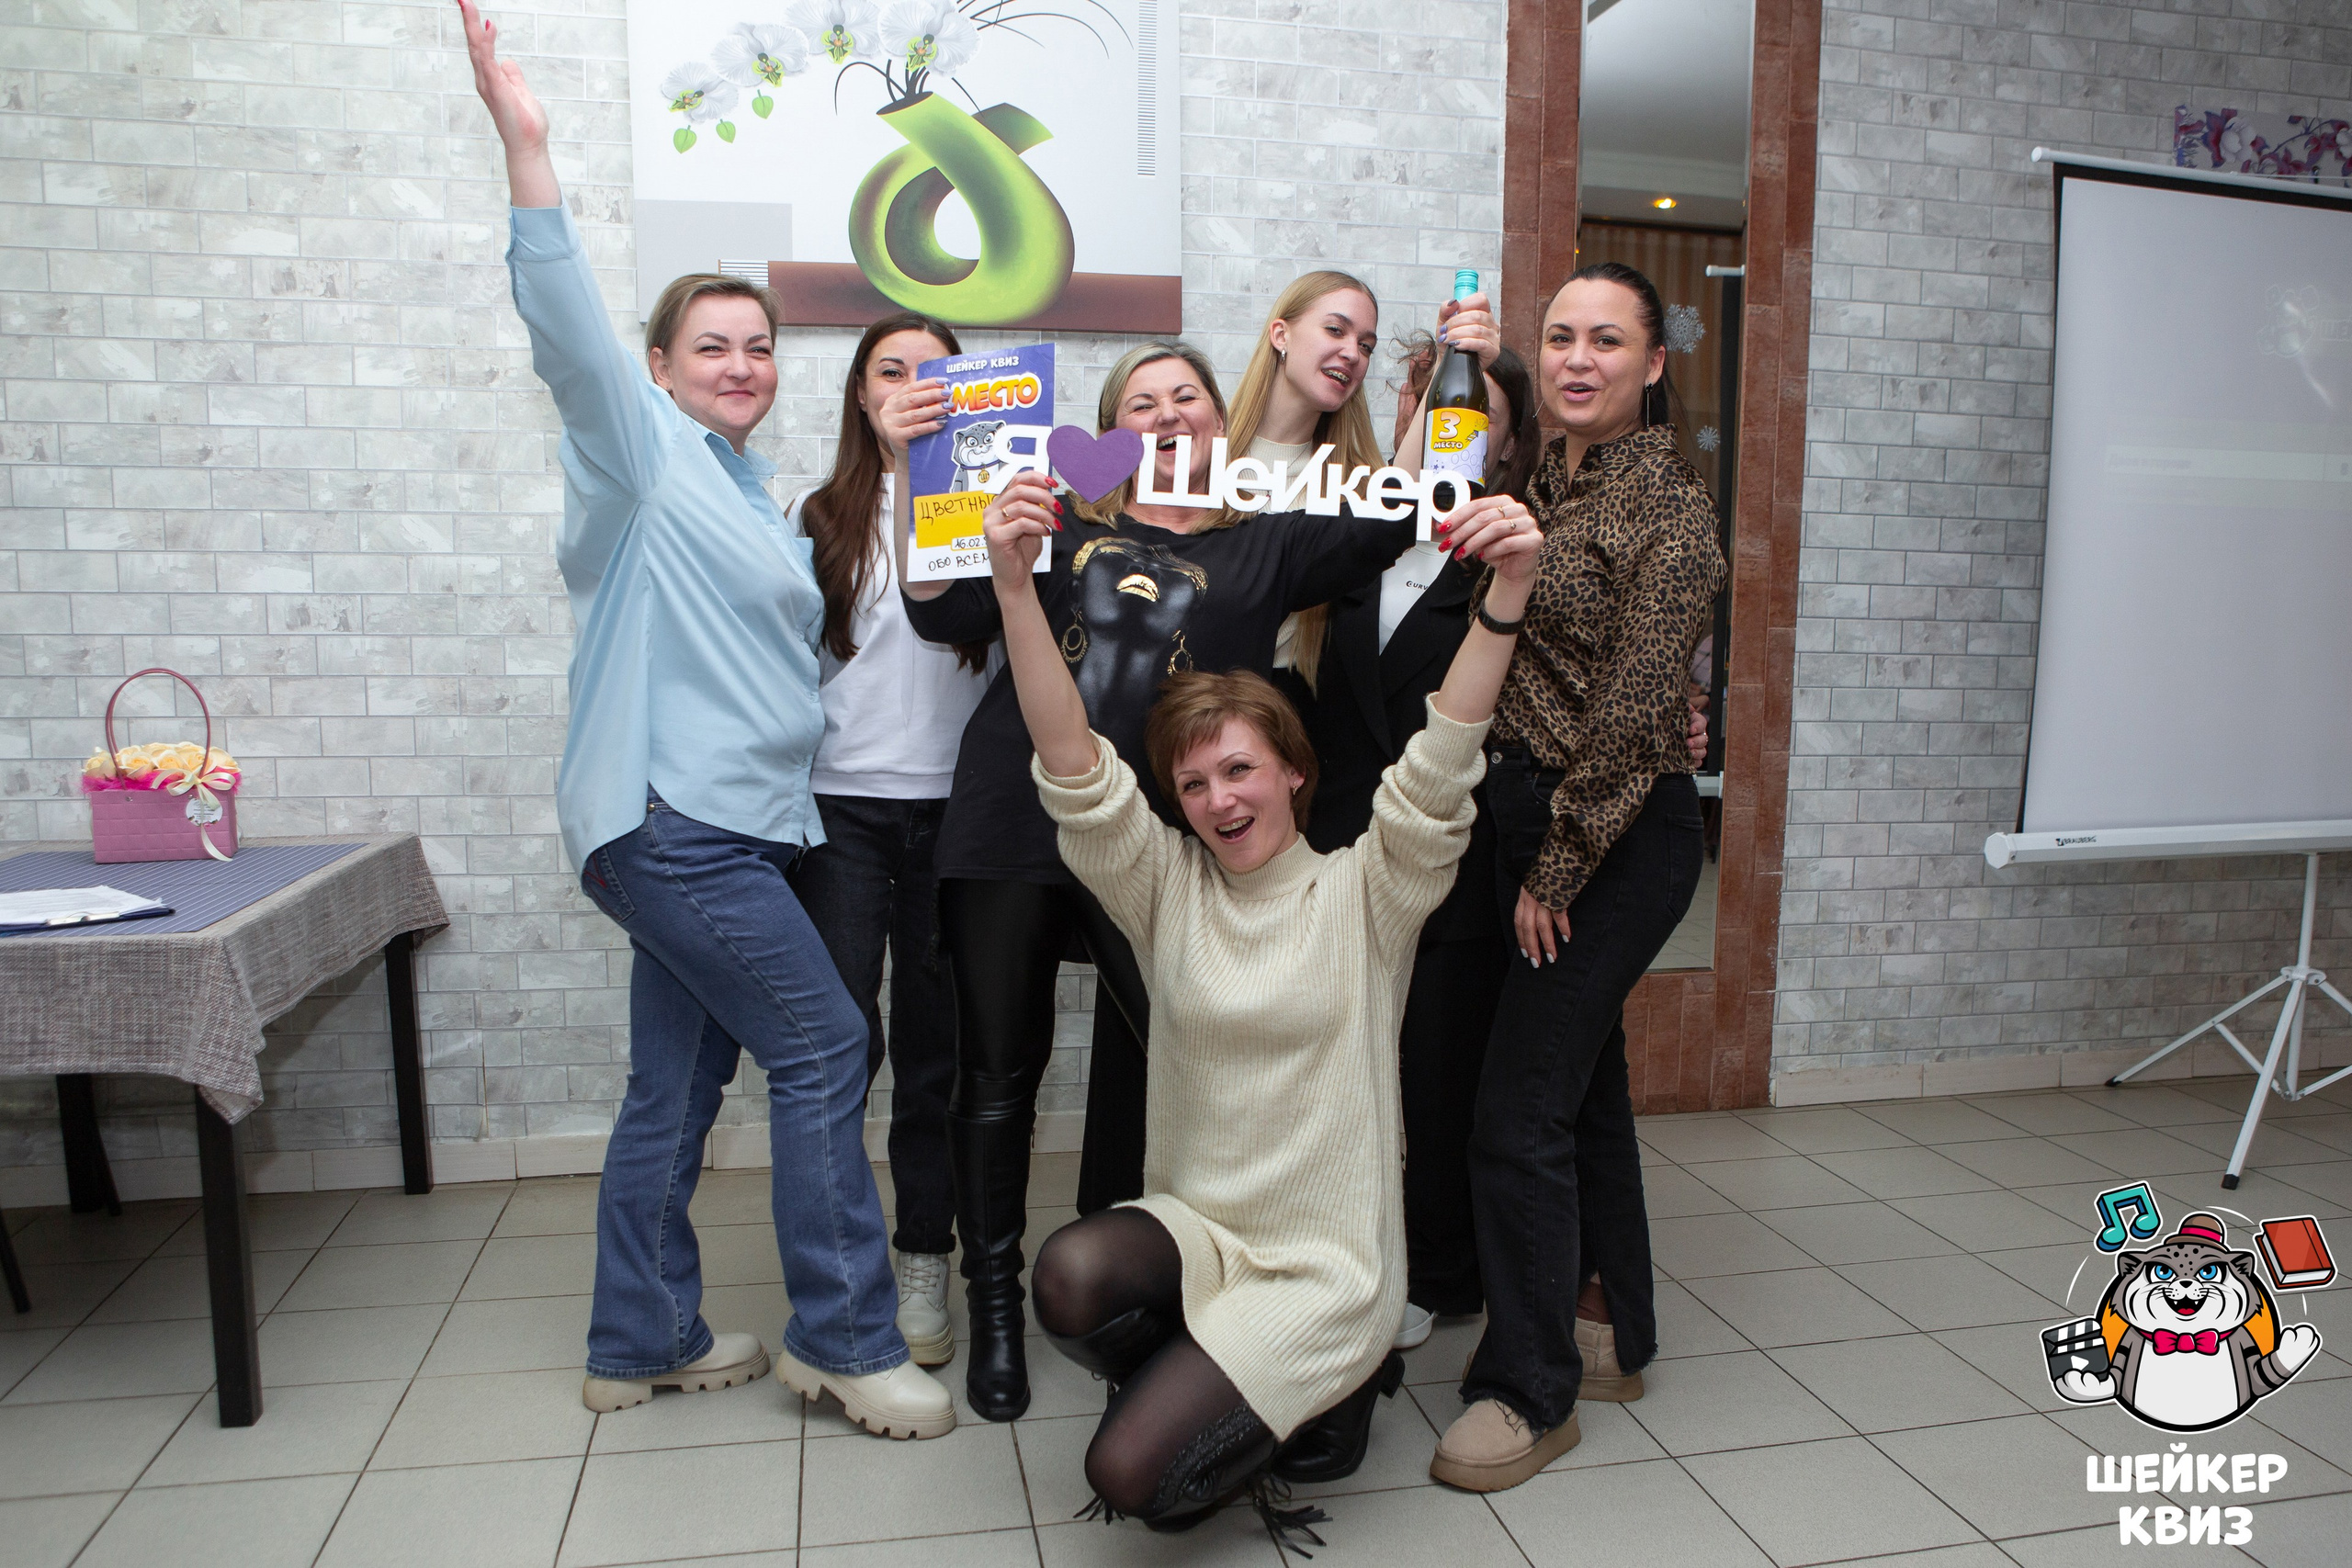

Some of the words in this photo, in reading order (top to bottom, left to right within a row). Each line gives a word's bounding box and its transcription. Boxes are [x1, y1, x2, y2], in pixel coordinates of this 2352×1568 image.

[946, 359, 988, 374] ШЕЙКЕР
[990, 355, 1020, 368] КВИЗ
[950, 376, 1039, 413] МЕСТО
[1438, 411, 1461, 440] 3
[1433, 441, 1464, 450] МЕСТО
[983, 423, 1053, 495] Я
[1136, 432, 1472, 542] Шейкер
